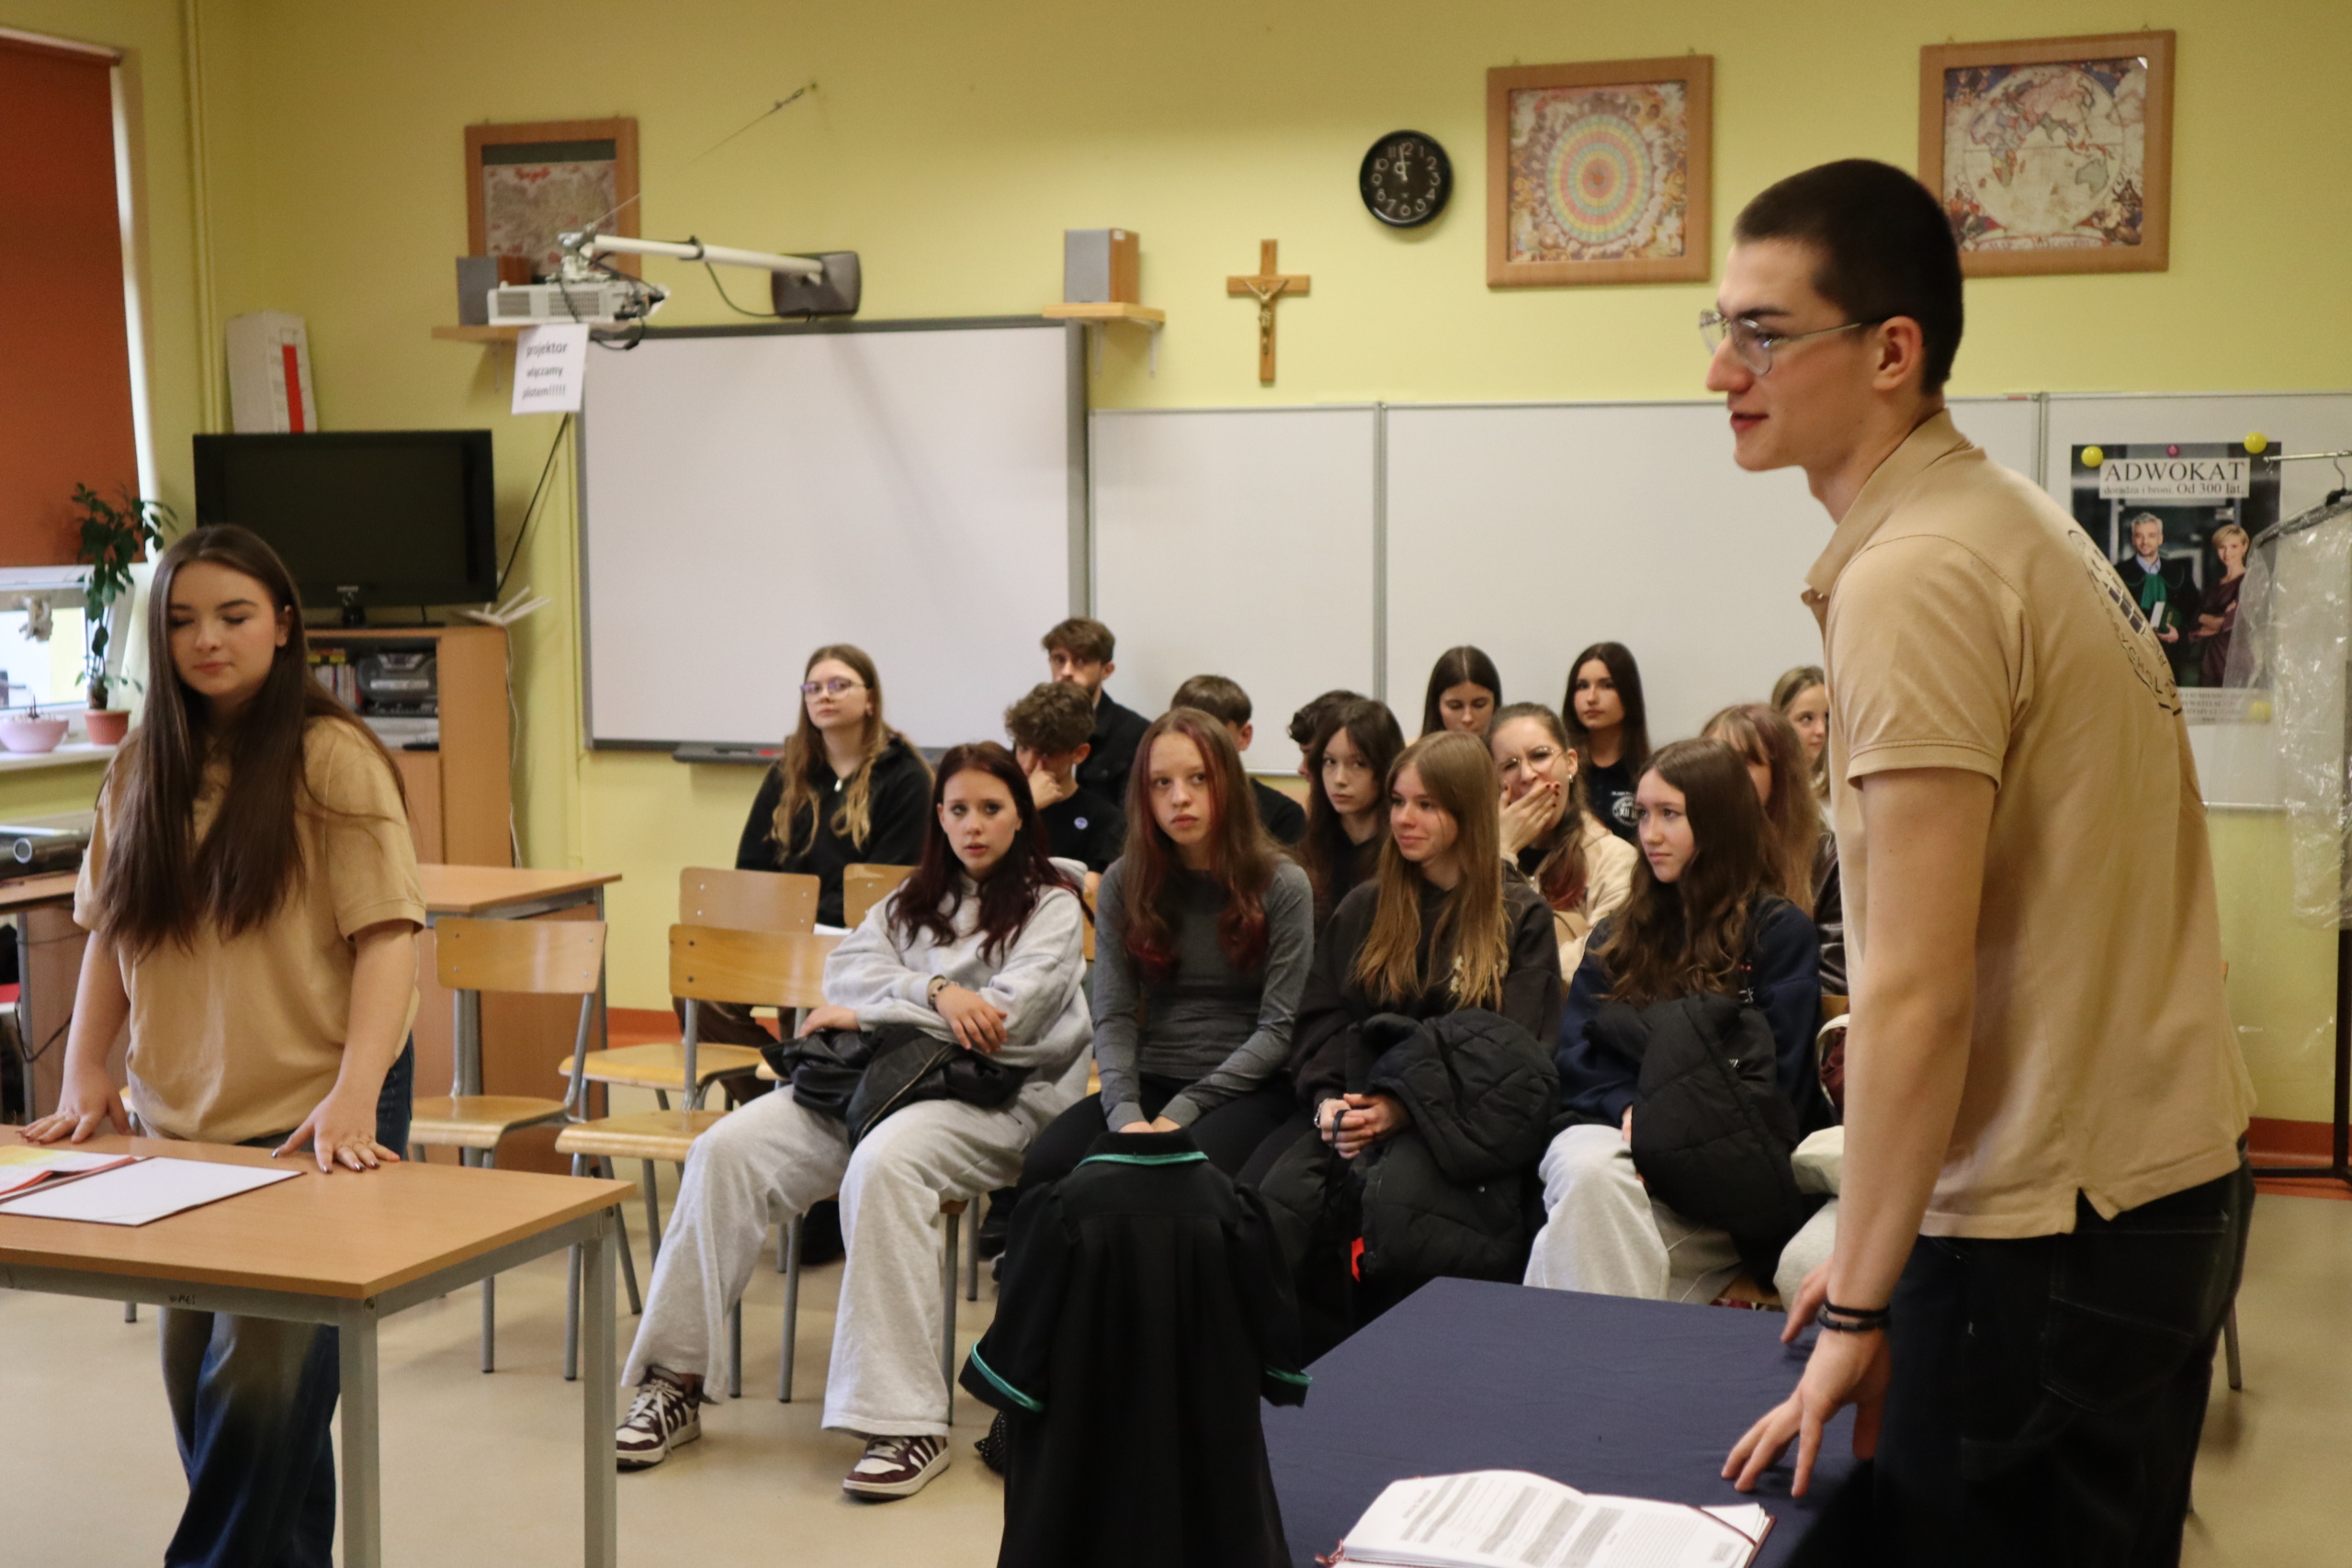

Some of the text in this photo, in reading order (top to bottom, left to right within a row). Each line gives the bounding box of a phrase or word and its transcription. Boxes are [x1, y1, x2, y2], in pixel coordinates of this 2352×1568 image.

[1426, 156, 1437, 171] 2
[1415, 197, 1426, 212] 5
[526, 341, 568, 358] projektor
[2105, 462, 2245, 481] ADWOKAT
[2104, 486, 2139, 495] doradza
[2177, 483, 2195, 495] Od
[2199, 483, 2222, 495] 300
[2226, 482, 2245, 494] lat.
